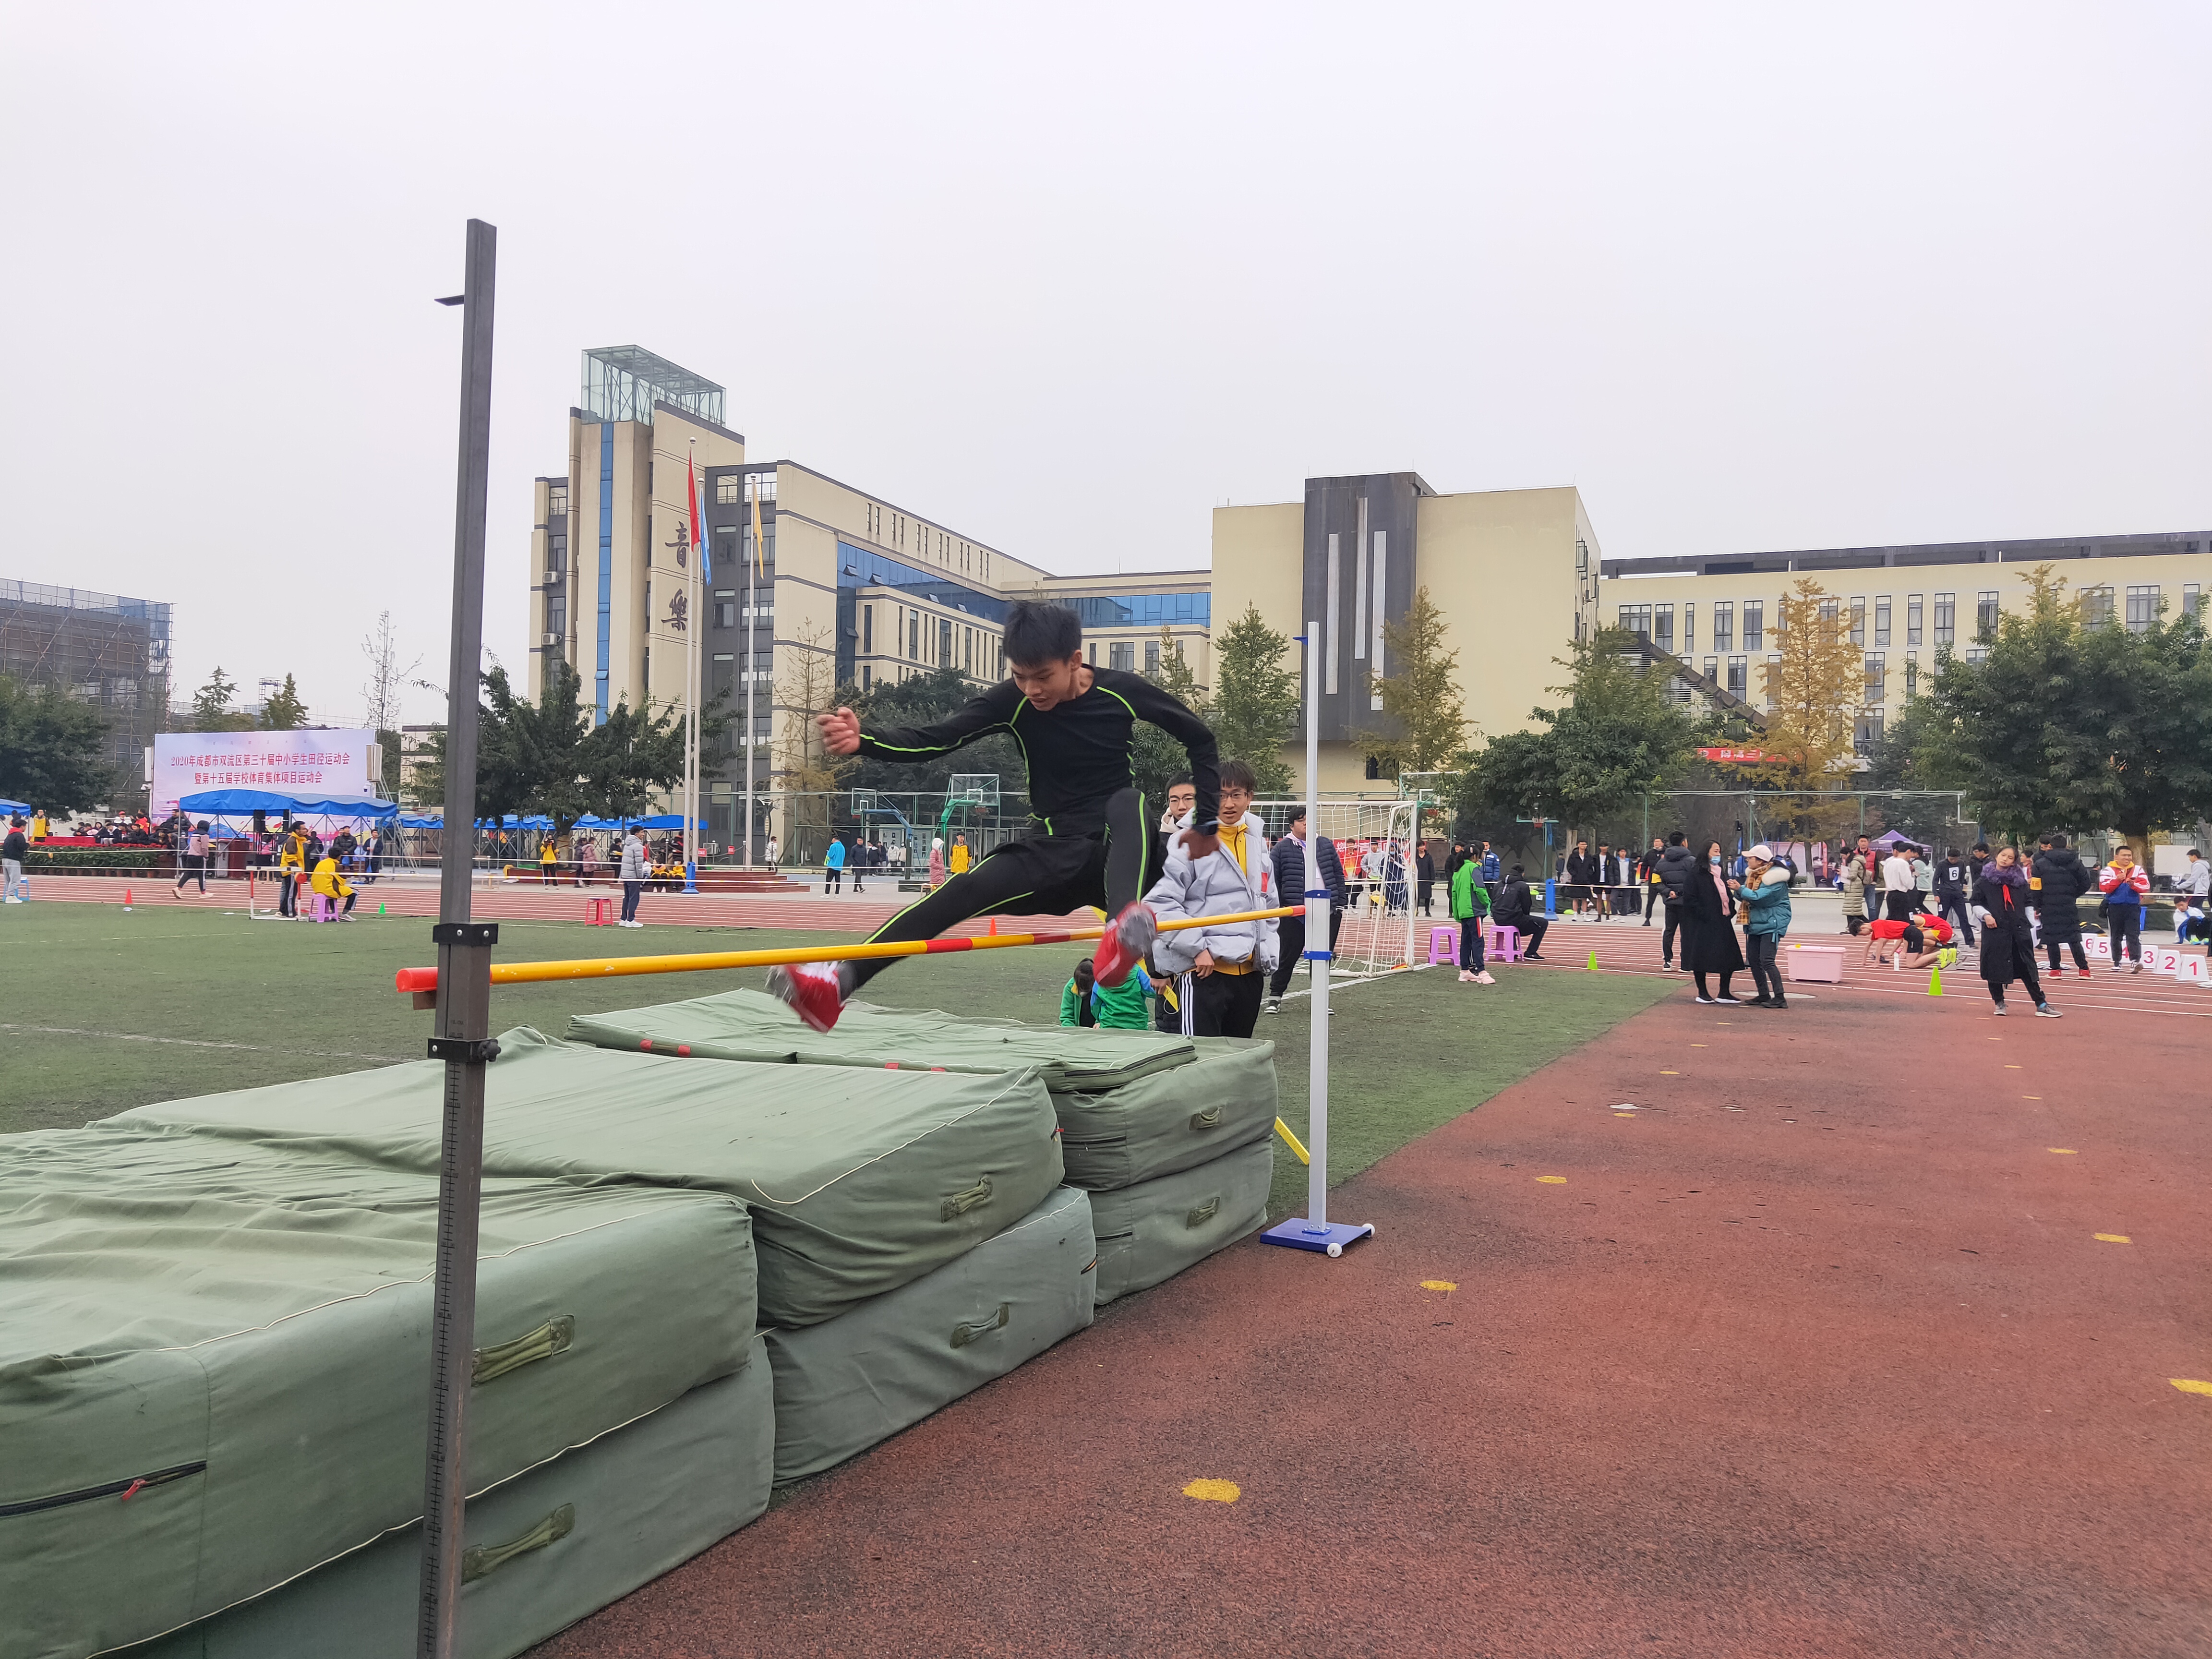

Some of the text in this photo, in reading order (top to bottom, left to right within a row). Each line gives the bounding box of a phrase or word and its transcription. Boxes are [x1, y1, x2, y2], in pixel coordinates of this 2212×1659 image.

[171, 752, 350, 767] 2020年成都市双流区第三十届中小学生田径运动会
[194, 770, 323, 785] 暨第十五届学校体育集体项目运动会
[1952, 870, 1957, 878] 6
[2085, 938, 2093, 950] 6
[2099, 942, 2108, 953] 5
[2122, 946, 2129, 958] 4
[2143, 950, 2154, 963] 3
[2164, 956, 2176, 970] 2
[2189, 961, 2197, 975] 1
